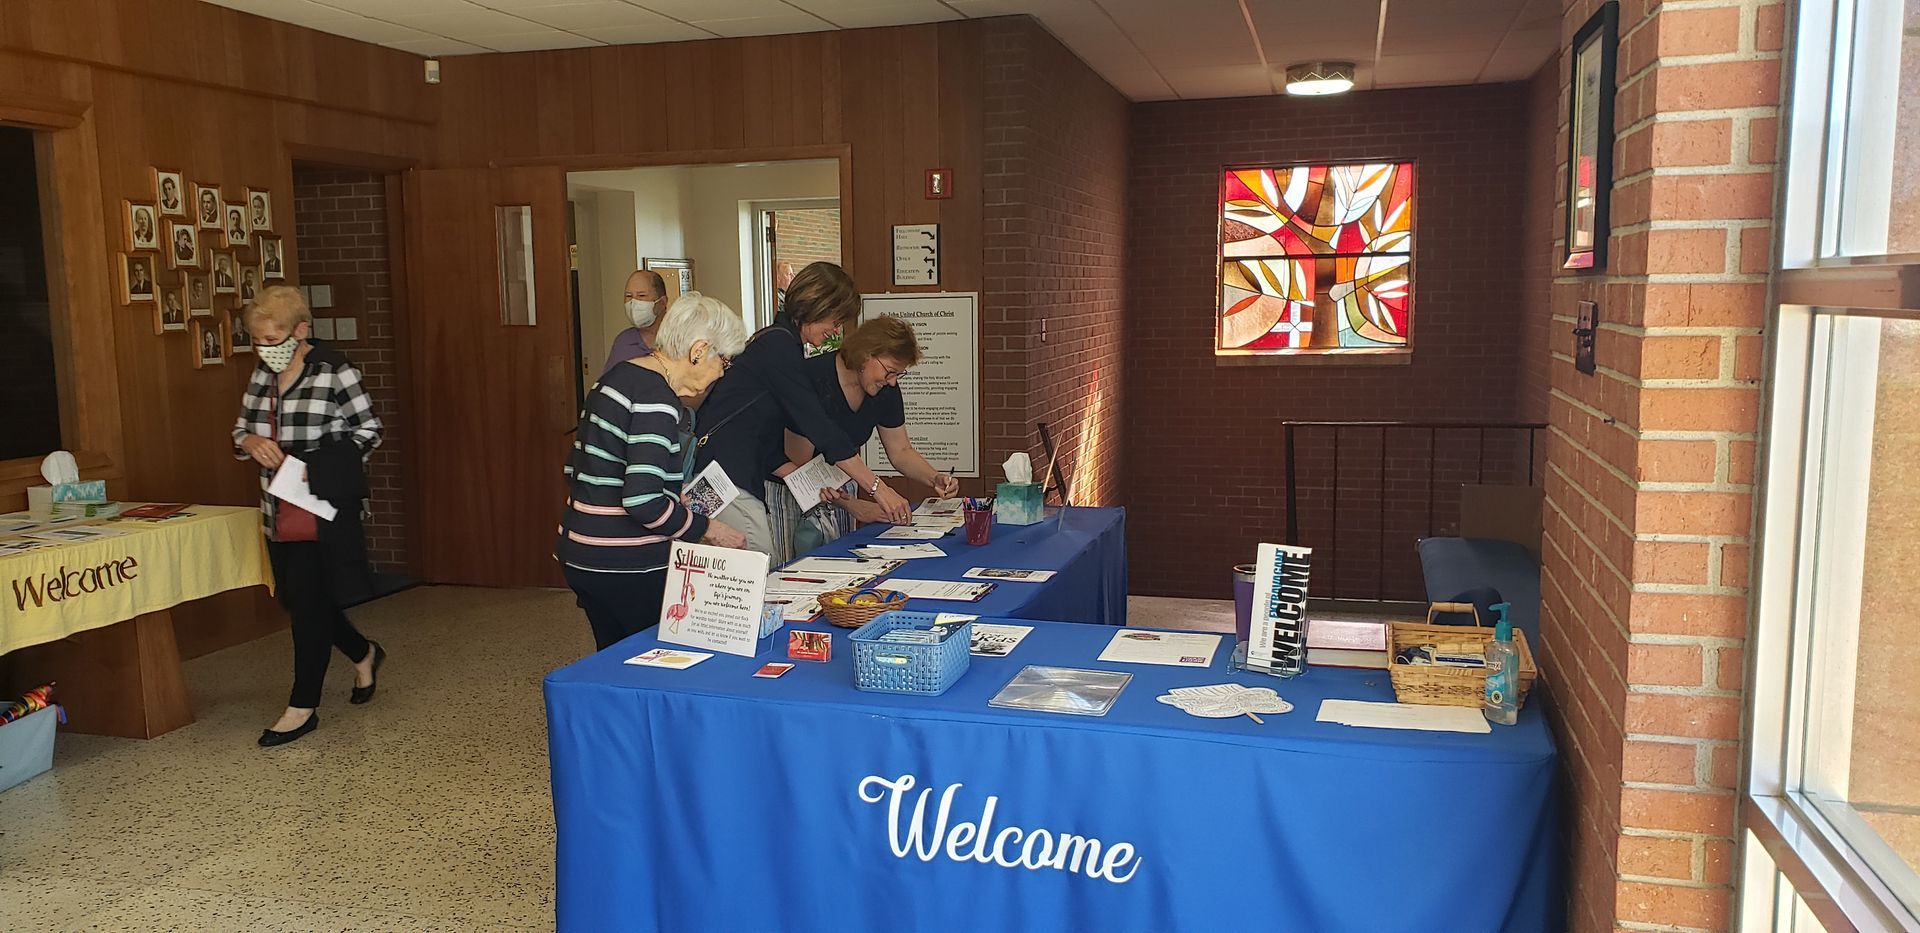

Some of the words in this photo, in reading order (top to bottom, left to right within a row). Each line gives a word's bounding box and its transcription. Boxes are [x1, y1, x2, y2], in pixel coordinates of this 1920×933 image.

[12, 556, 138, 611] Welcome
[712, 558, 727, 571] UCC
[1270, 551, 1312, 668] WELCOME
[858, 774, 1142, 884] Welcome
